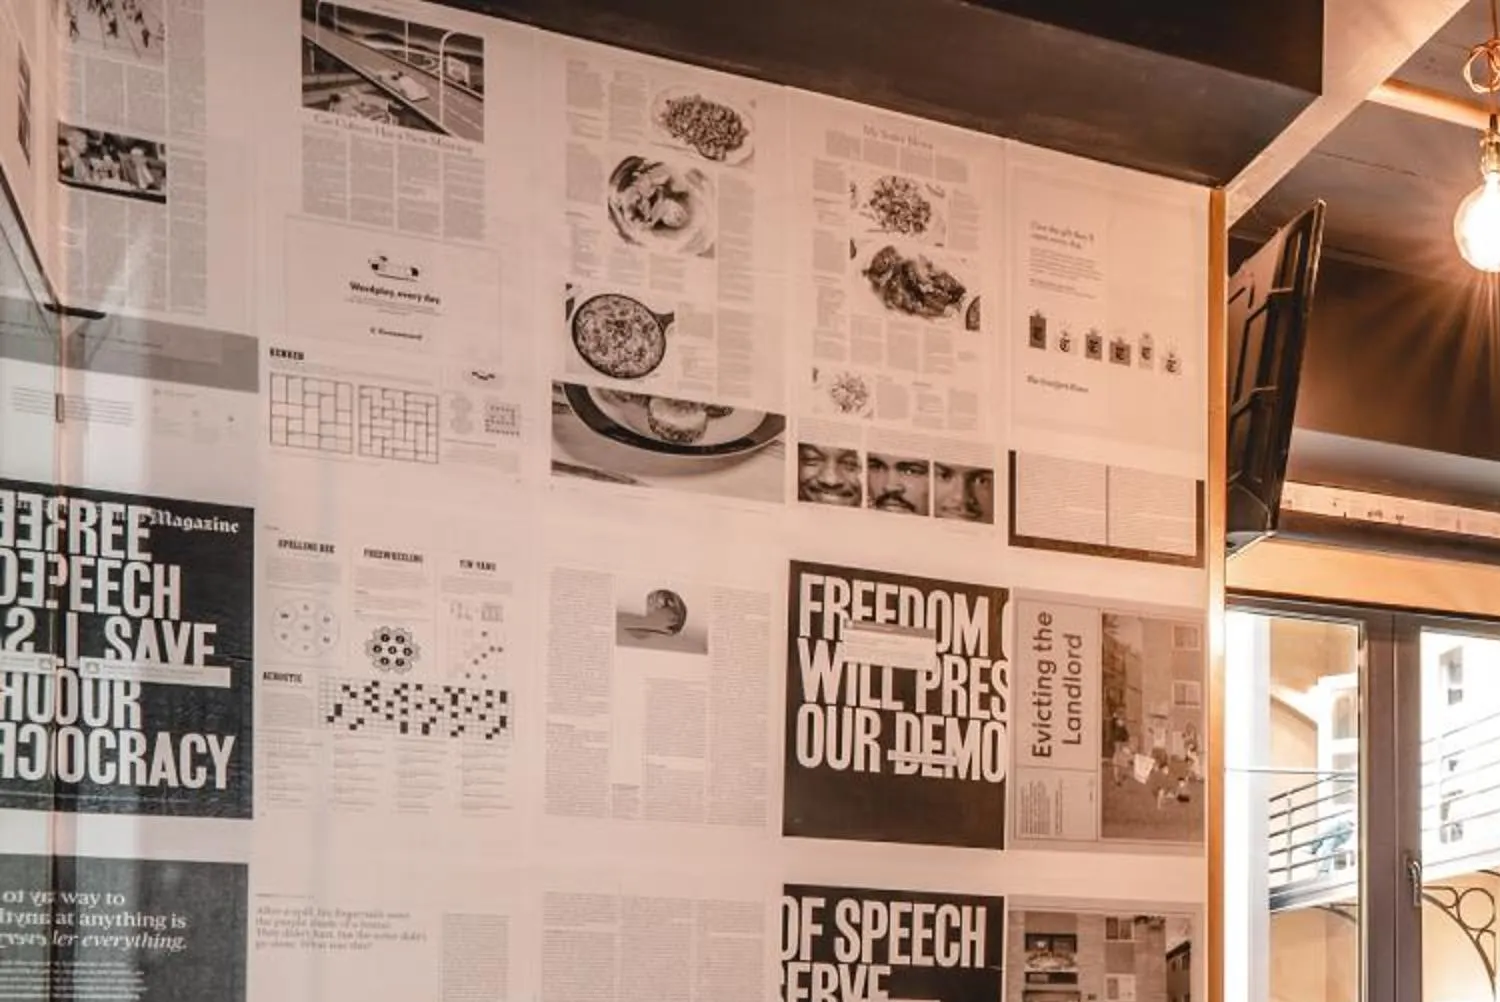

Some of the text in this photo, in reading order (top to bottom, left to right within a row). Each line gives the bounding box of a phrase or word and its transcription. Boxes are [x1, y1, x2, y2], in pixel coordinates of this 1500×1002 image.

[148, 508, 240, 534] Magazine
[800, 572, 989, 658] FREEDOM
[1032, 610, 1053, 652] the
[797, 638, 904, 711] WILL
[1031, 658, 1057, 758] Evicting
[1061, 633, 1082, 745] Landlord
[796, 703, 882, 774] OUR
[79, 911, 168, 930] anything
[170, 911, 188, 930] is
[105, 890, 126, 906] to
[834, 898, 987, 968] SPEECH
[81, 932, 188, 953] everything.
